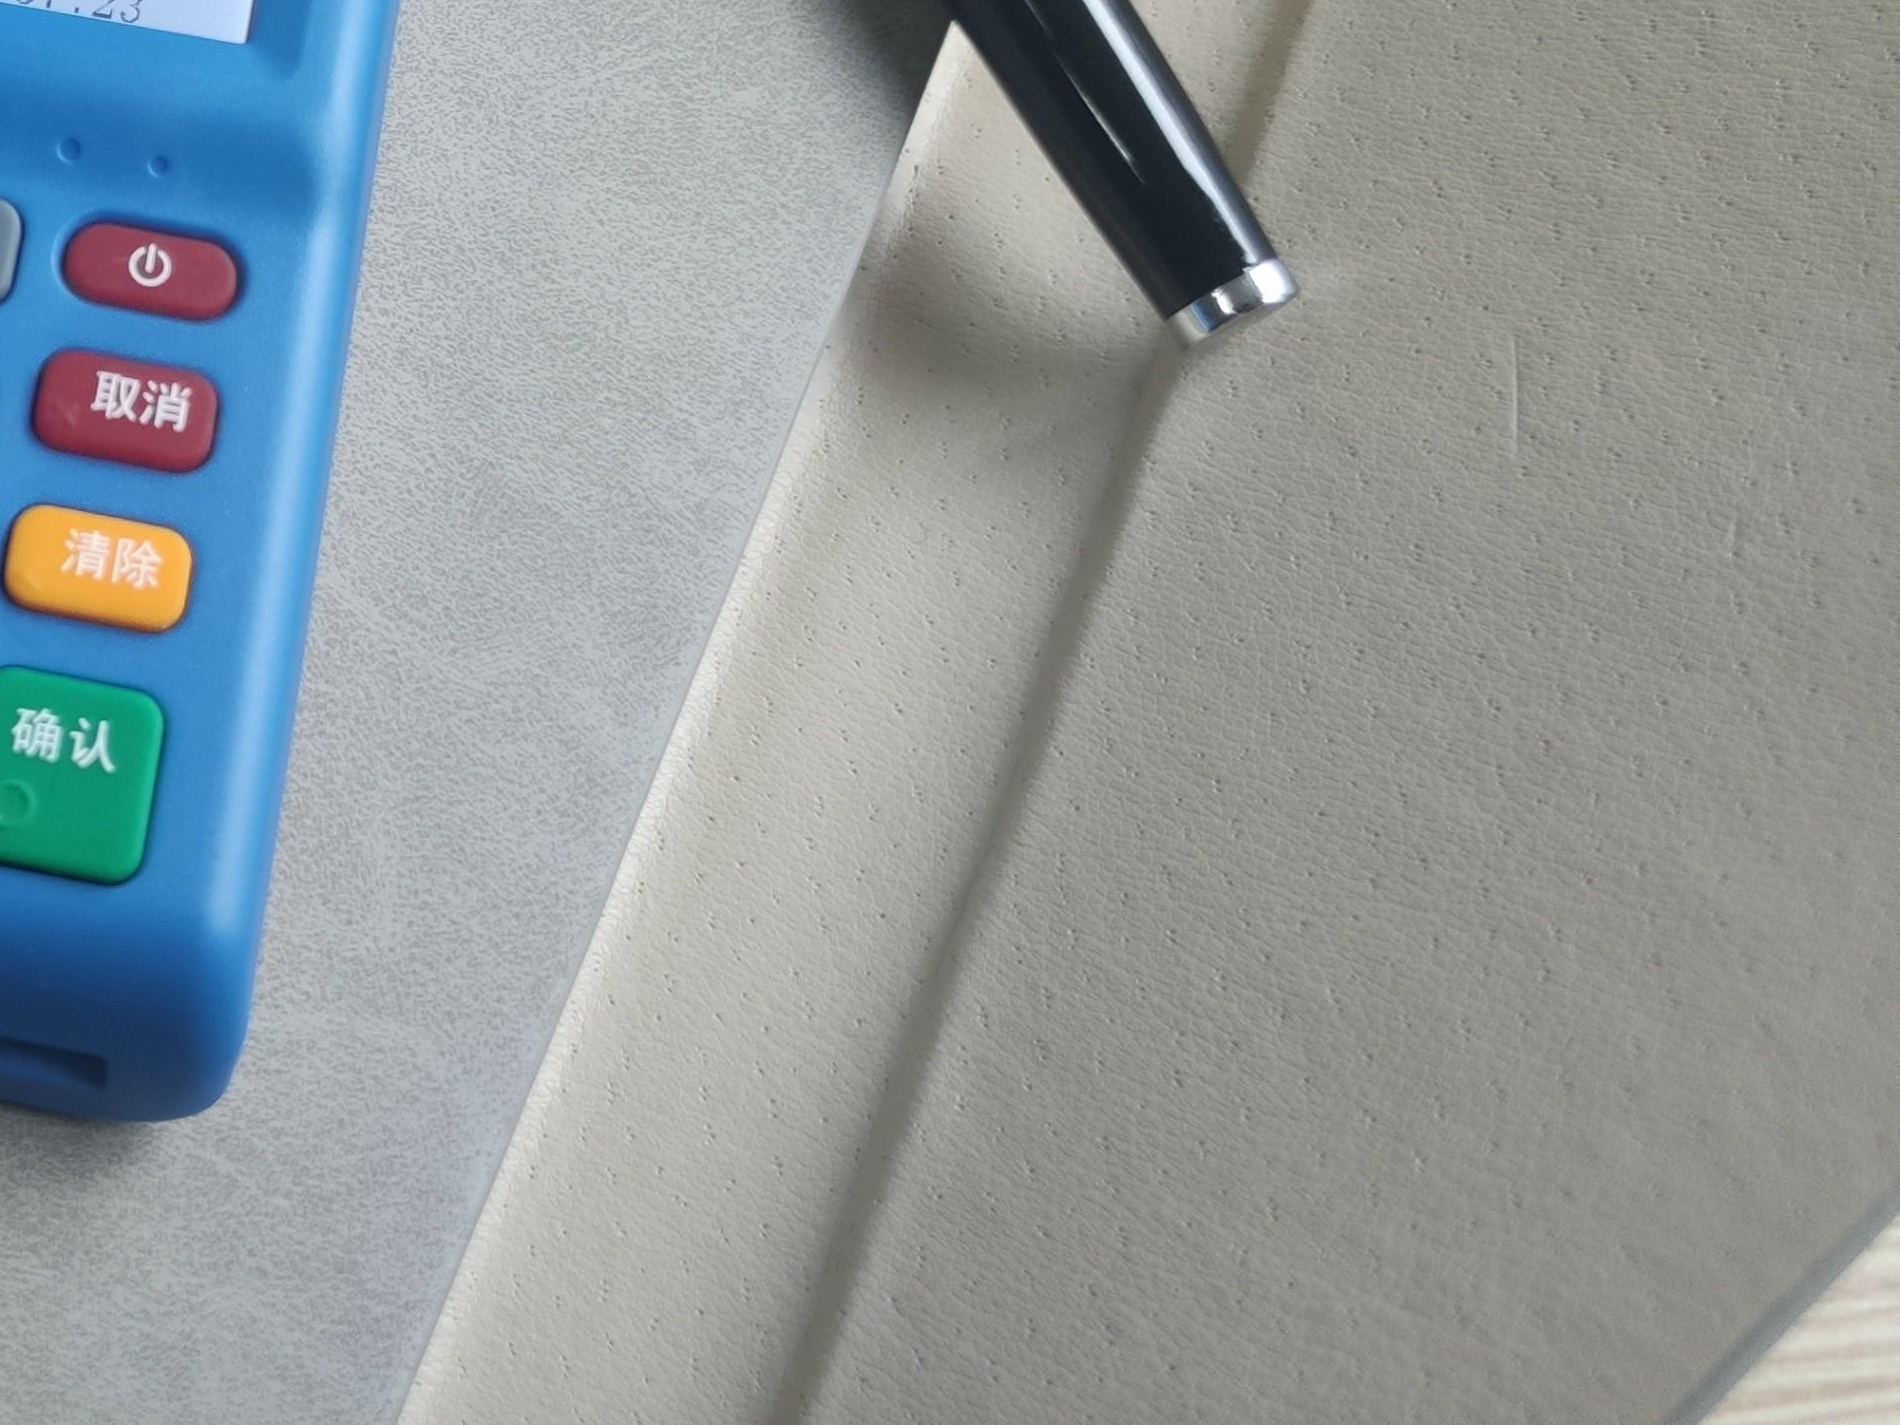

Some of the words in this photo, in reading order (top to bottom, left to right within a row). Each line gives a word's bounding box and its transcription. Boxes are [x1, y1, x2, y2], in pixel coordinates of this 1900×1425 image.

[90, 369, 193, 433] 取消
[60, 528, 164, 590] 清除
[11, 707, 117, 774] 确认
